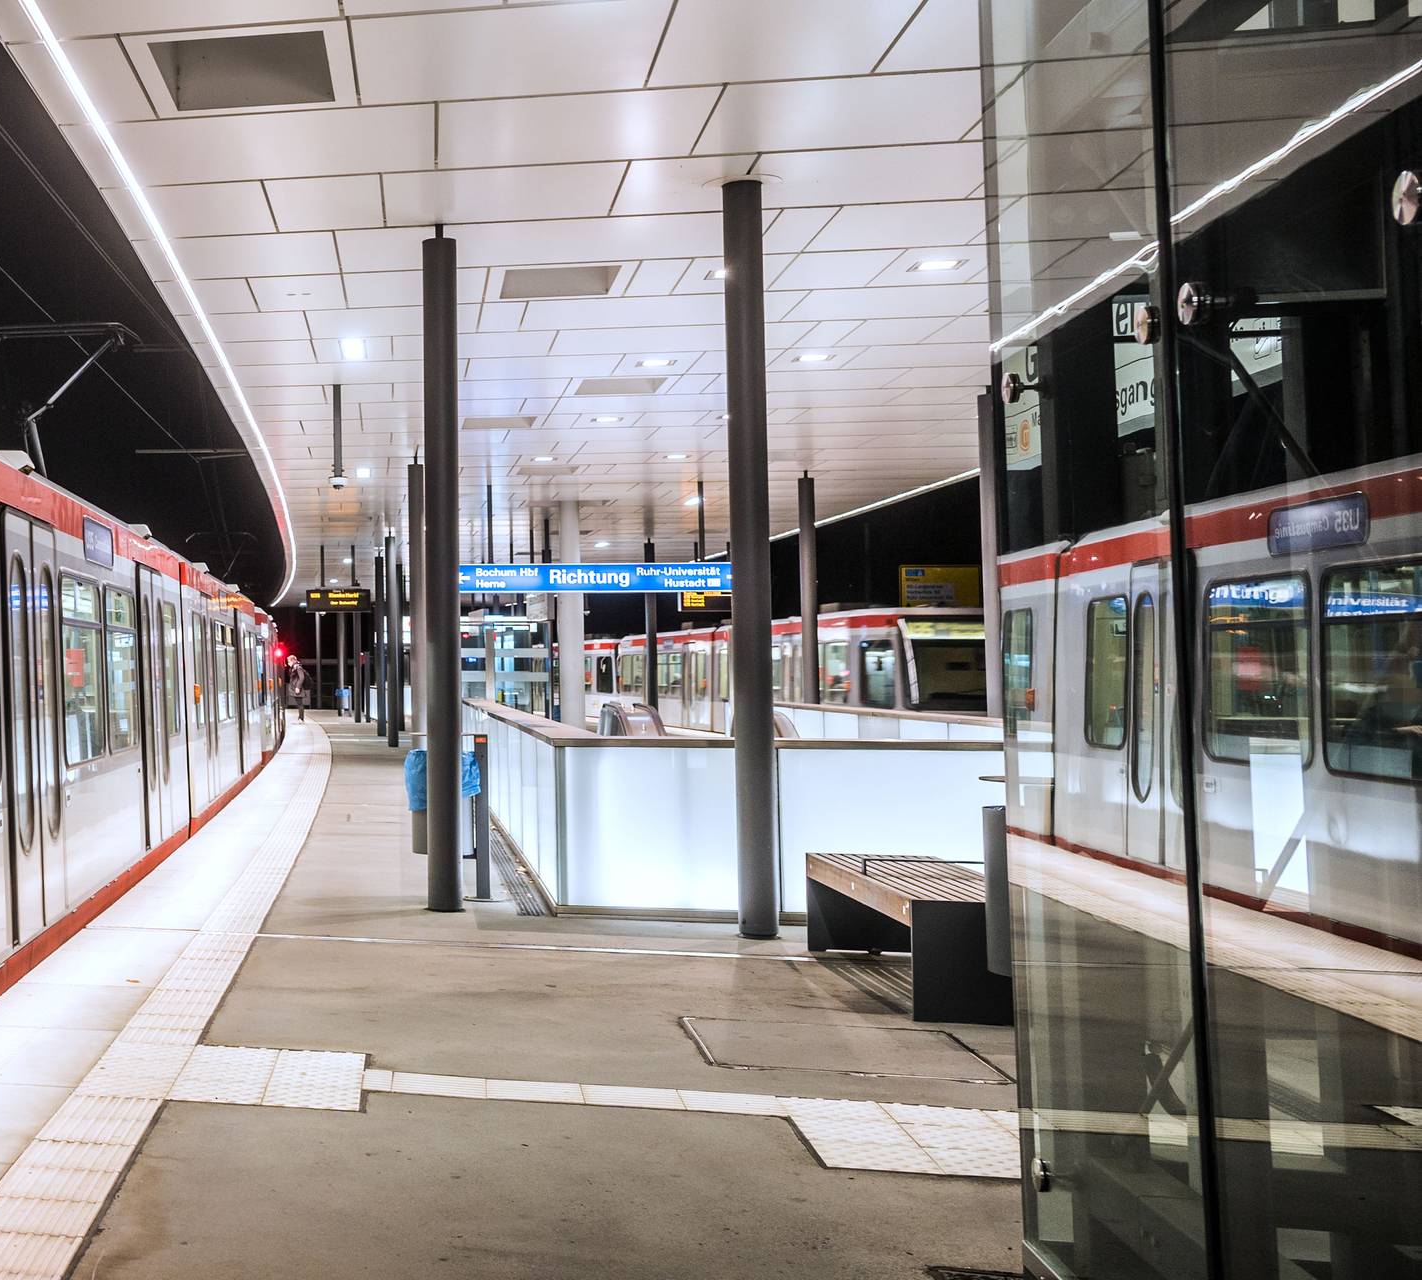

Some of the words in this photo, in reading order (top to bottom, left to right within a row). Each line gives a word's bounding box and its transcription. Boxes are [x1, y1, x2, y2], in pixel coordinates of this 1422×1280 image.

[475, 567, 517, 577] Bochum
[519, 567, 539, 577] Hbf
[636, 567, 721, 576] Ruhr-Universität
[549, 569, 630, 587] Richtung
[664, 578, 706, 588] Hustadt
[475, 580, 506, 589] Herne
